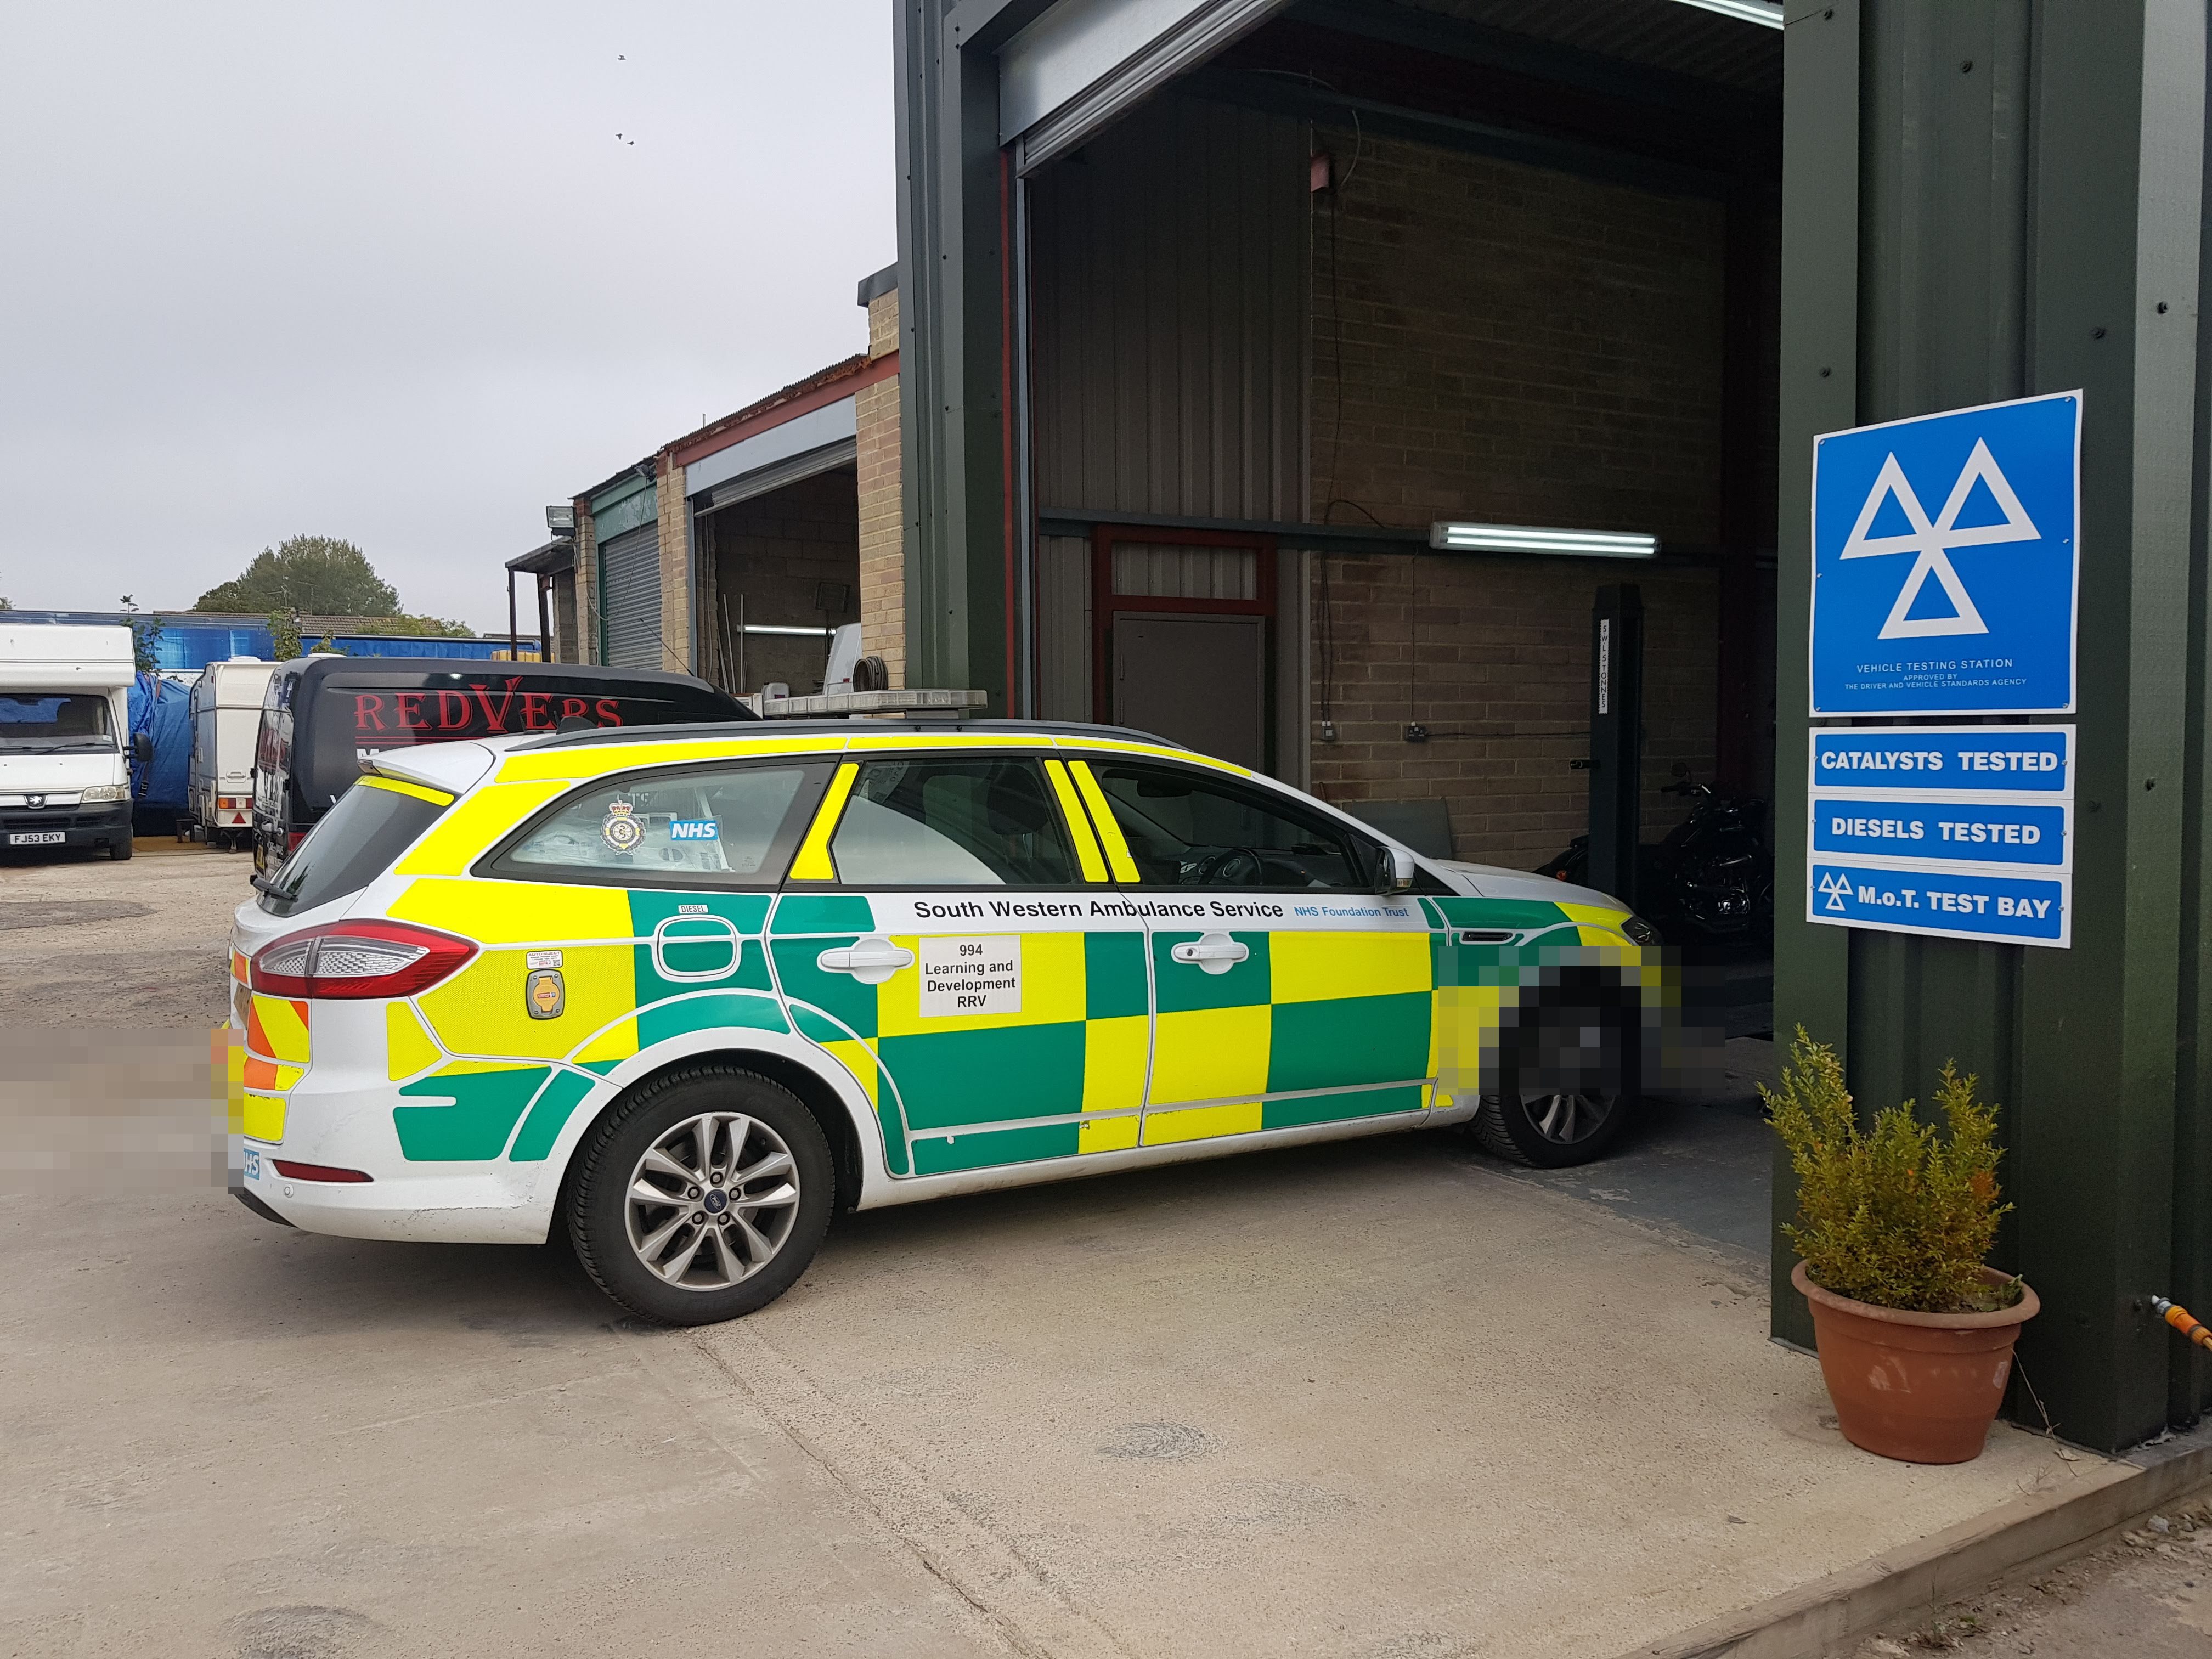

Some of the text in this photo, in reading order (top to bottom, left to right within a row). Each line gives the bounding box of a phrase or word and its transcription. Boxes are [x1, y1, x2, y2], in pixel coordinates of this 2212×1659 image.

[1857, 659, 2012, 672] VEHICLE TESTING STATION
[1822, 752, 2057, 771] CATALYSTS TESTED
[15, 833, 60, 843] FJ53 EKY
[672, 823, 715, 838] NHS
[1832, 818, 2040, 844] DIESELS TESTED
[915, 901, 1409, 918] South Western Ambulance Service NHS Foundation Trust
[1859, 886, 2051, 918] M.o.T. TEST BAY
[960, 944, 983, 956] 994
[926, 960, 1013, 975] Learning and
[928, 978, 1015, 992] Development
[958, 995, 986, 1007] RRV
[244, 1151, 259, 1175] HS
